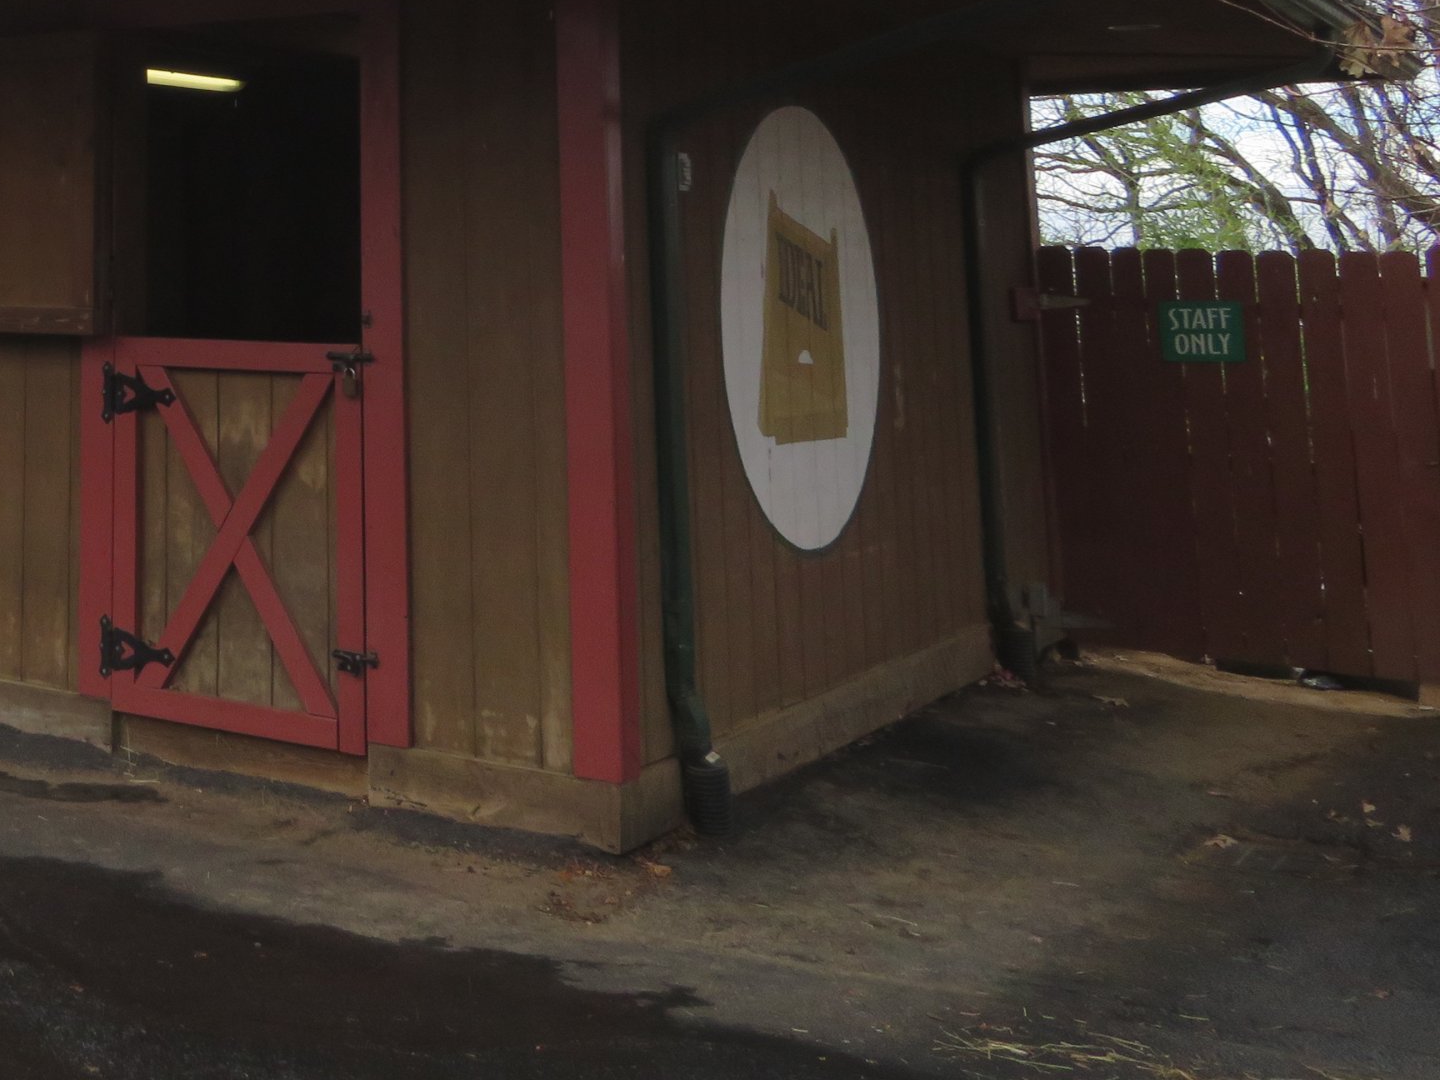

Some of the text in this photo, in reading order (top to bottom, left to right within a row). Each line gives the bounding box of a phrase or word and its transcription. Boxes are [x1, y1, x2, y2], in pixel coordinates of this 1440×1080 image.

[775, 231, 830, 332] IDEAL
[1168, 307, 1232, 331] STAFF
[1174, 333, 1232, 355] ONLY
